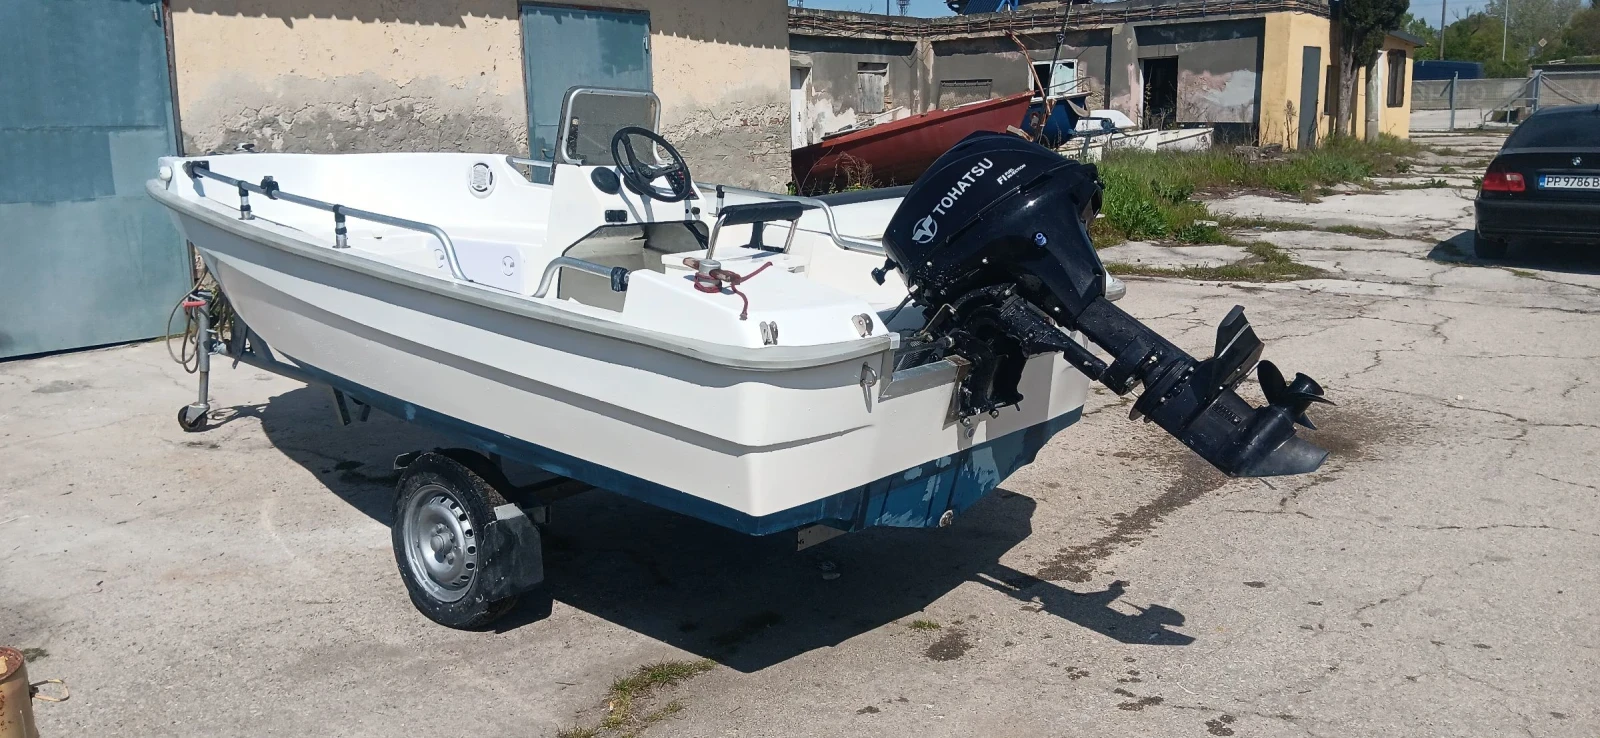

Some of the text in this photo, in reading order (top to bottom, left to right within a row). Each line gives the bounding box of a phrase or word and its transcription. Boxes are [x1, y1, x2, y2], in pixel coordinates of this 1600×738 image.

[932, 157, 994, 215] TOHATSU
[996, 174, 1008, 186] FI
[1563, 176, 1590, 187] 9786
